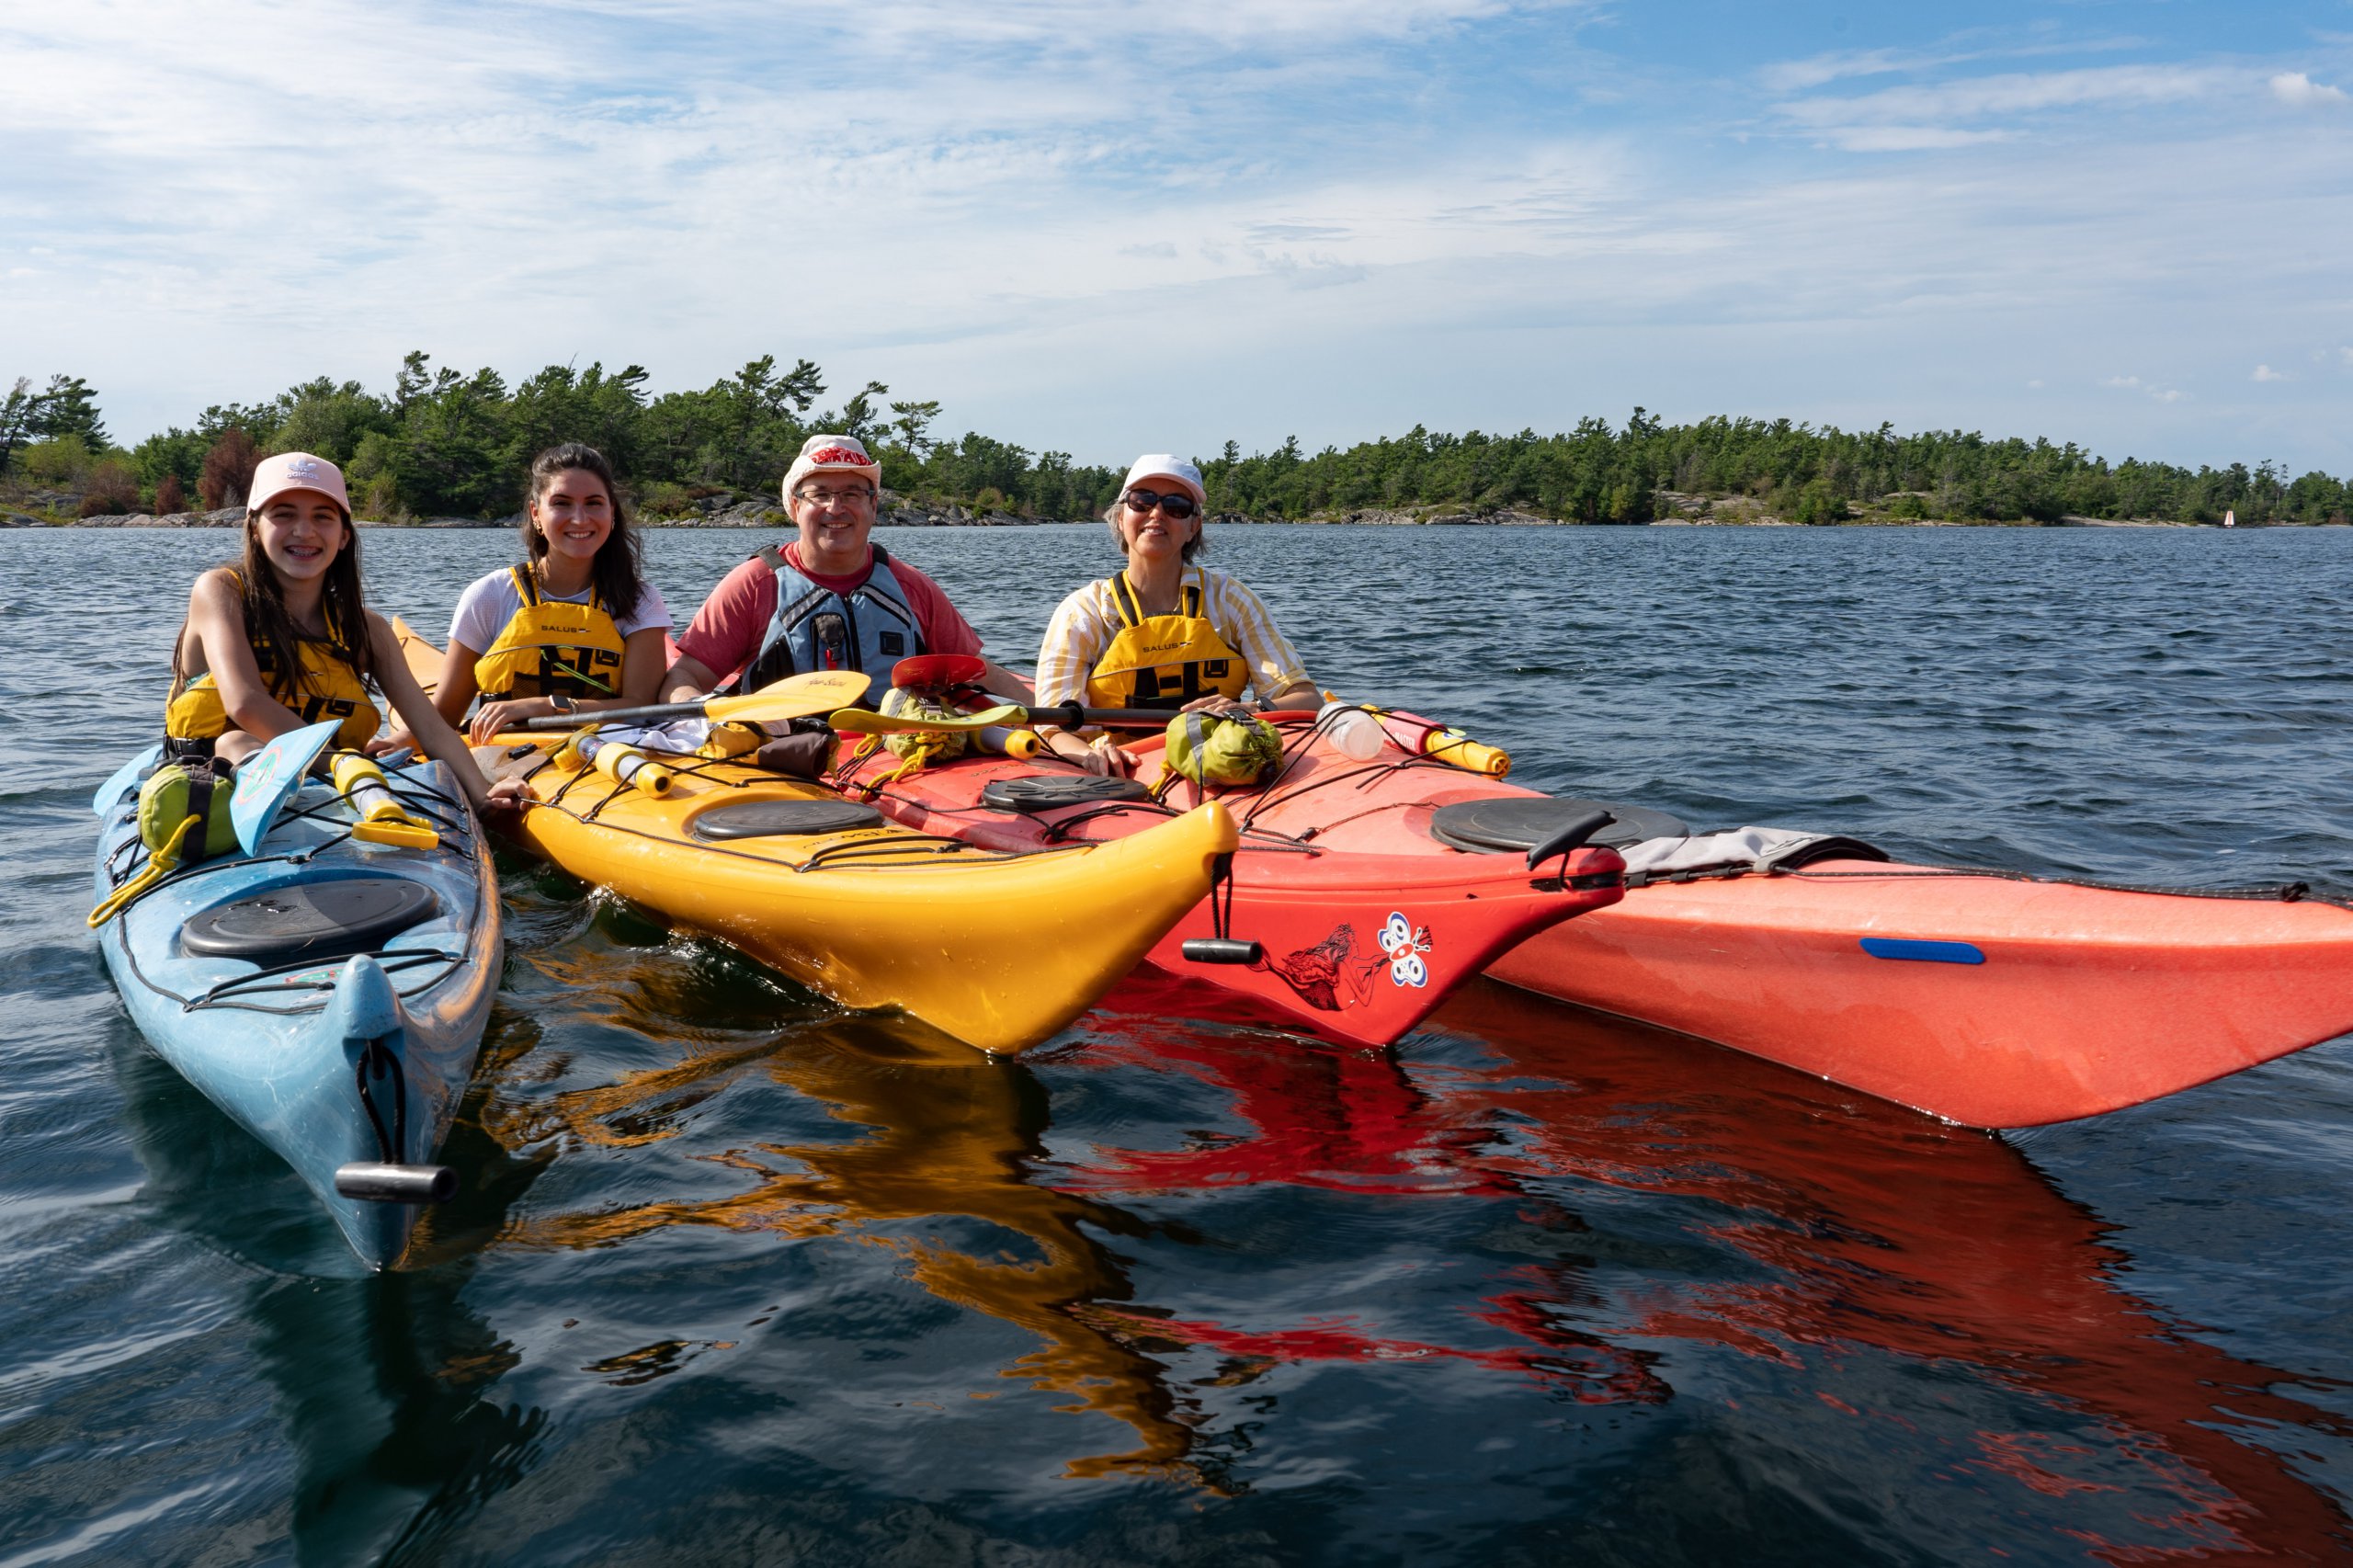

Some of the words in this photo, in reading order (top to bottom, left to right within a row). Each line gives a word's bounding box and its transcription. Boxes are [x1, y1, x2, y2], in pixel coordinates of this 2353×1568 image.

[287, 471, 319, 480] adidas
[541, 625, 577, 633] SALUS
[1142, 642, 1178, 653] SALUS
